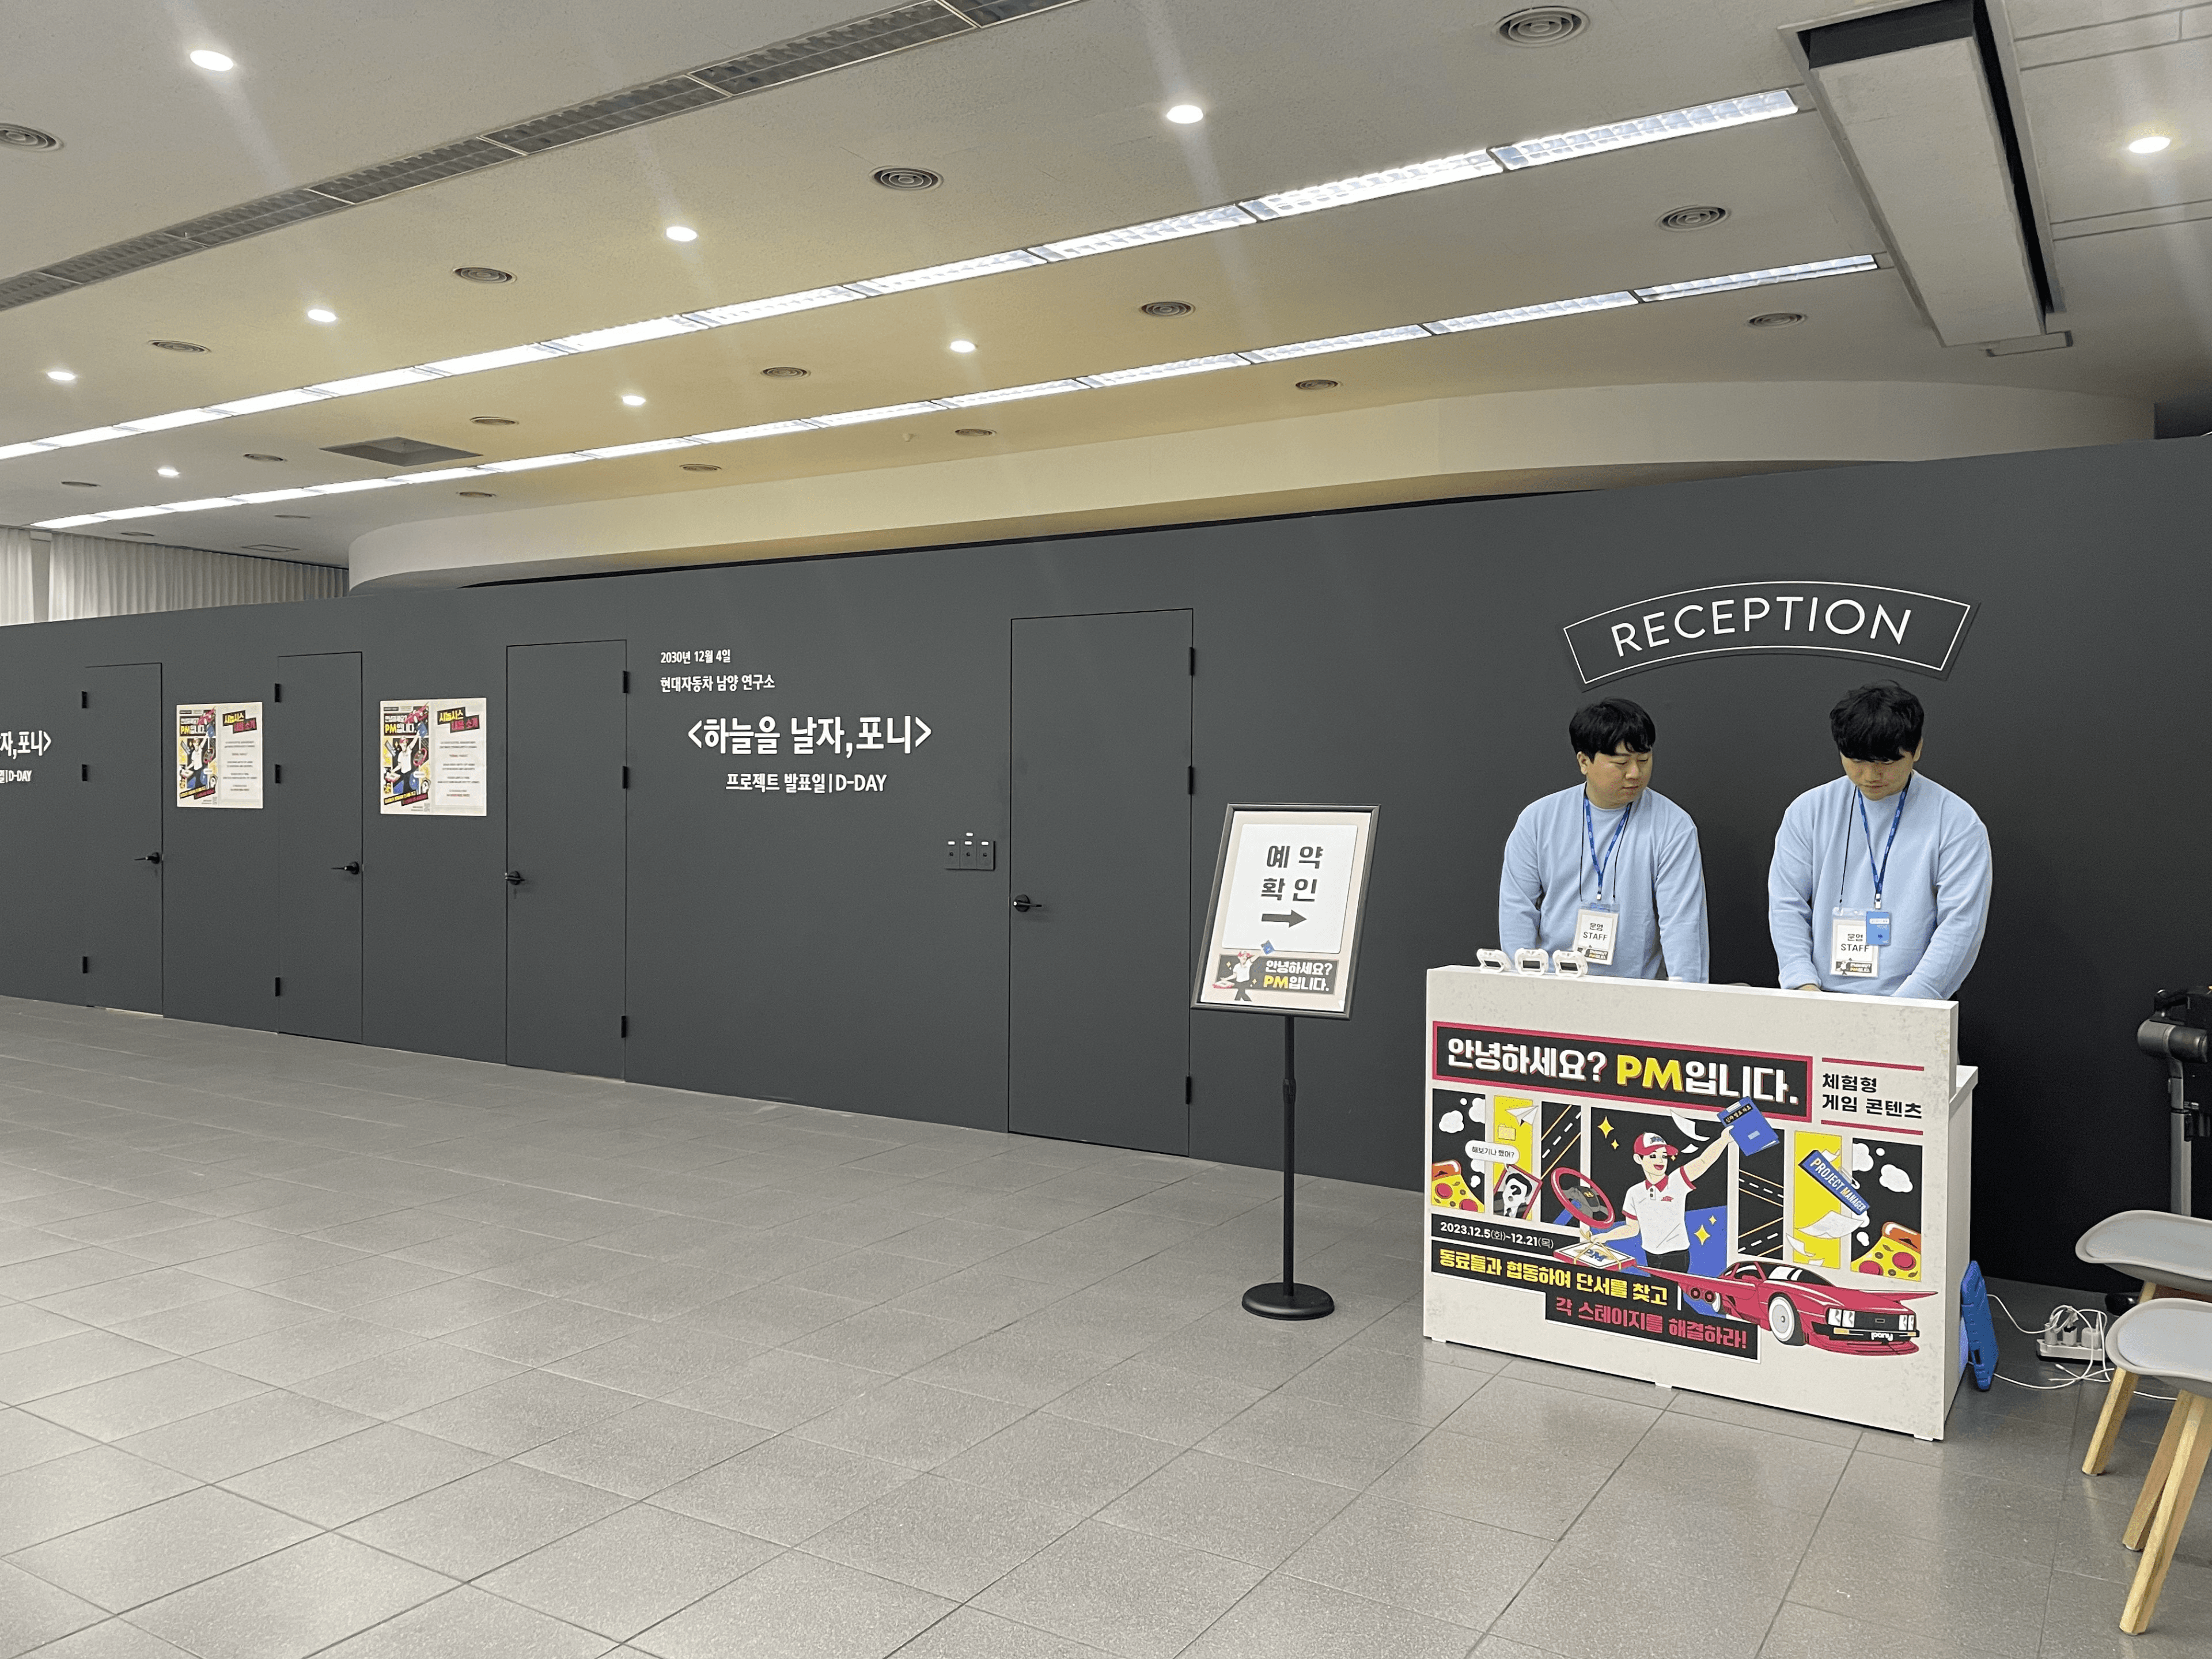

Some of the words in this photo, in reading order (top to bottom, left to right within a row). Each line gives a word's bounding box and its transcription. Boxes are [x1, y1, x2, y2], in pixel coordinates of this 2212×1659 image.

[1611, 597, 1911, 657] RECEPTION
[660, 650, 691, 664] 2030년
[694, 649, 714, 664] 12월
[715, 649, 731, 663] 4일
[660, 676, 713, 692] 현대자동차
[717, 675, 738, 691] 남양
[741, 673, 775, 690] 연구소
[688, 716, 781, 755] <하늘을
[726, 773, 781, 793] 프로젝트
[1583, 931, 1608, 941] STAFF
[1590, 922, 1603, 931] 운영
[1840, 943, 1870, 952] STAFF
[1847, 933, 1863, 942] 운영
[1264, 959, 1333, 976] 안녕하세요?
[1263, 975, 1330, 992] PM입니다.
[1448, 1037, 1608, 1082] 안녕하세요?
[1616, 1054, 1799, 1105] PM입니다.
[1822, 1073, 1877, 1093] 체험형
[1822, 1094, 1858, 1113] 게임
[1866, 1098, 1922, 1119] 콘텐츠
[1810, 1157, 1846, 1191] PROJECT
[1840, 1187, 1867, 1212] MANAGER
[1440, 1248, 1502, 1276] 동료들과
[1506, 1260, 1571, 1289] 협동하여
[1576, 1272, 1627, 1299] 단서를
[1632, 1282, 1668, 1306] 찾고
[1556, 1297, 1572, 1317] 각
[1578, 1301, 1664, 1334] 스테이지를
[1668, 1317, 1747, 1349] 해결하라!
